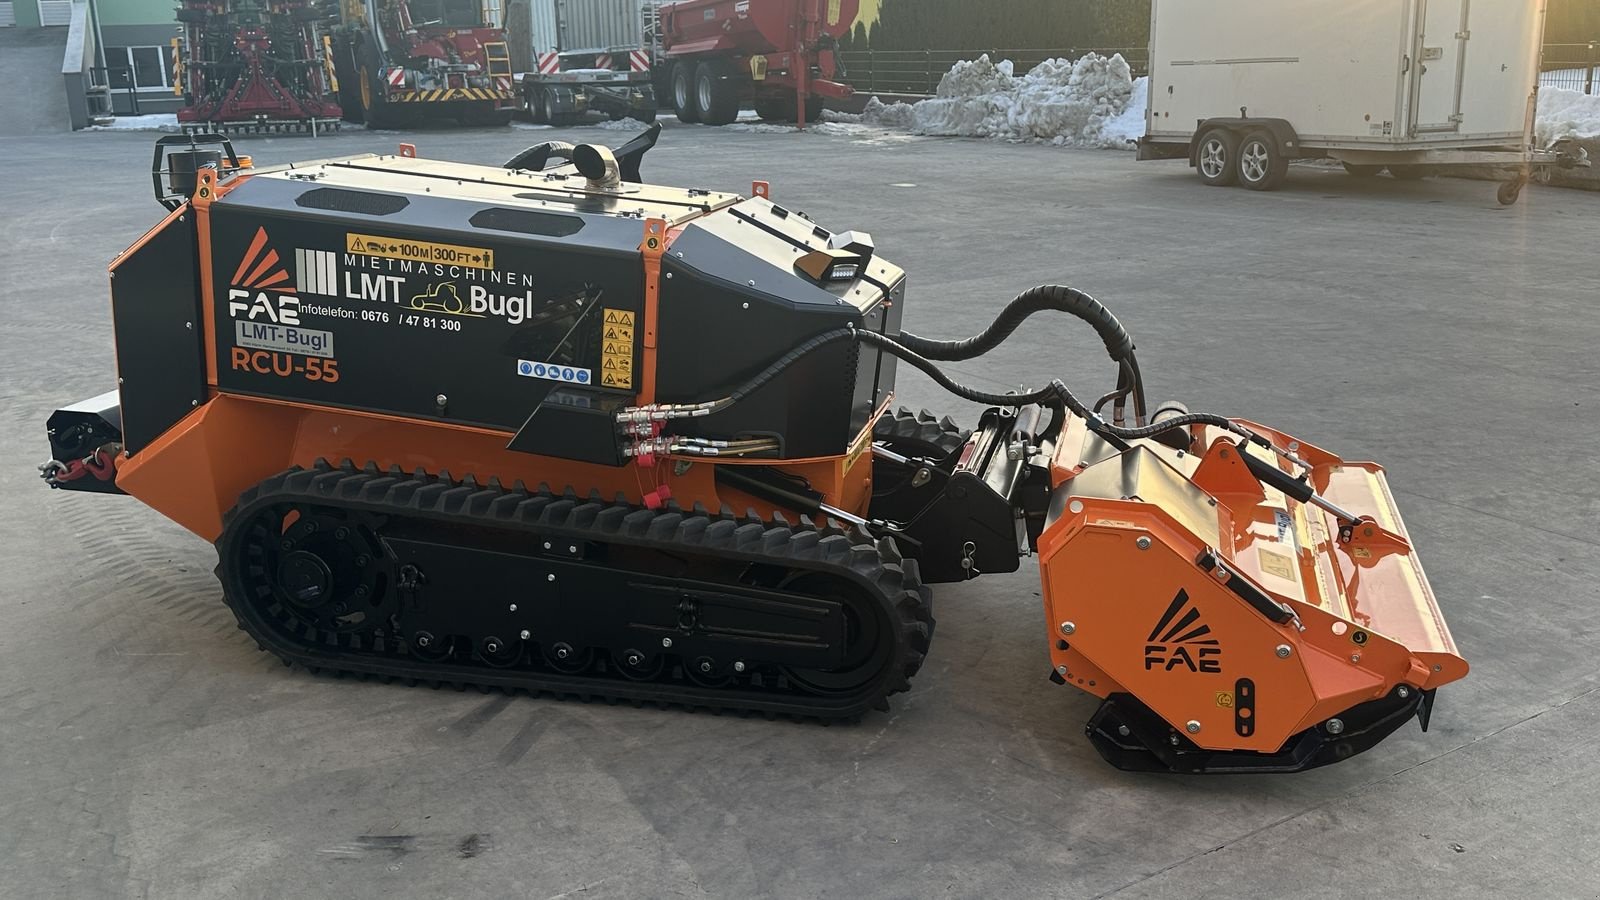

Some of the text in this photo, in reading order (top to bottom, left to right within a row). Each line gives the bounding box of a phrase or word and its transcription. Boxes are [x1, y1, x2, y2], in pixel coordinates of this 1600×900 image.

[344, 253, 533, 287] MIETMASCHINEN
[229, 288, 300, 326] FAE
[345, 271, 533, 325] LMT Bugl
[298, 303, 359, 320] Infotelefon:
[361, 310, 390, 323] 0676
[405, 315, 420, 327] 47
[423, 317, 437, 329] 81
[440, 319, 461, 331] 300
[241, 322, 327, 351] LMT-Bugl
[231, 347, 340, 383] RCU-55
[1145, 645, 1221, 673] FAE
